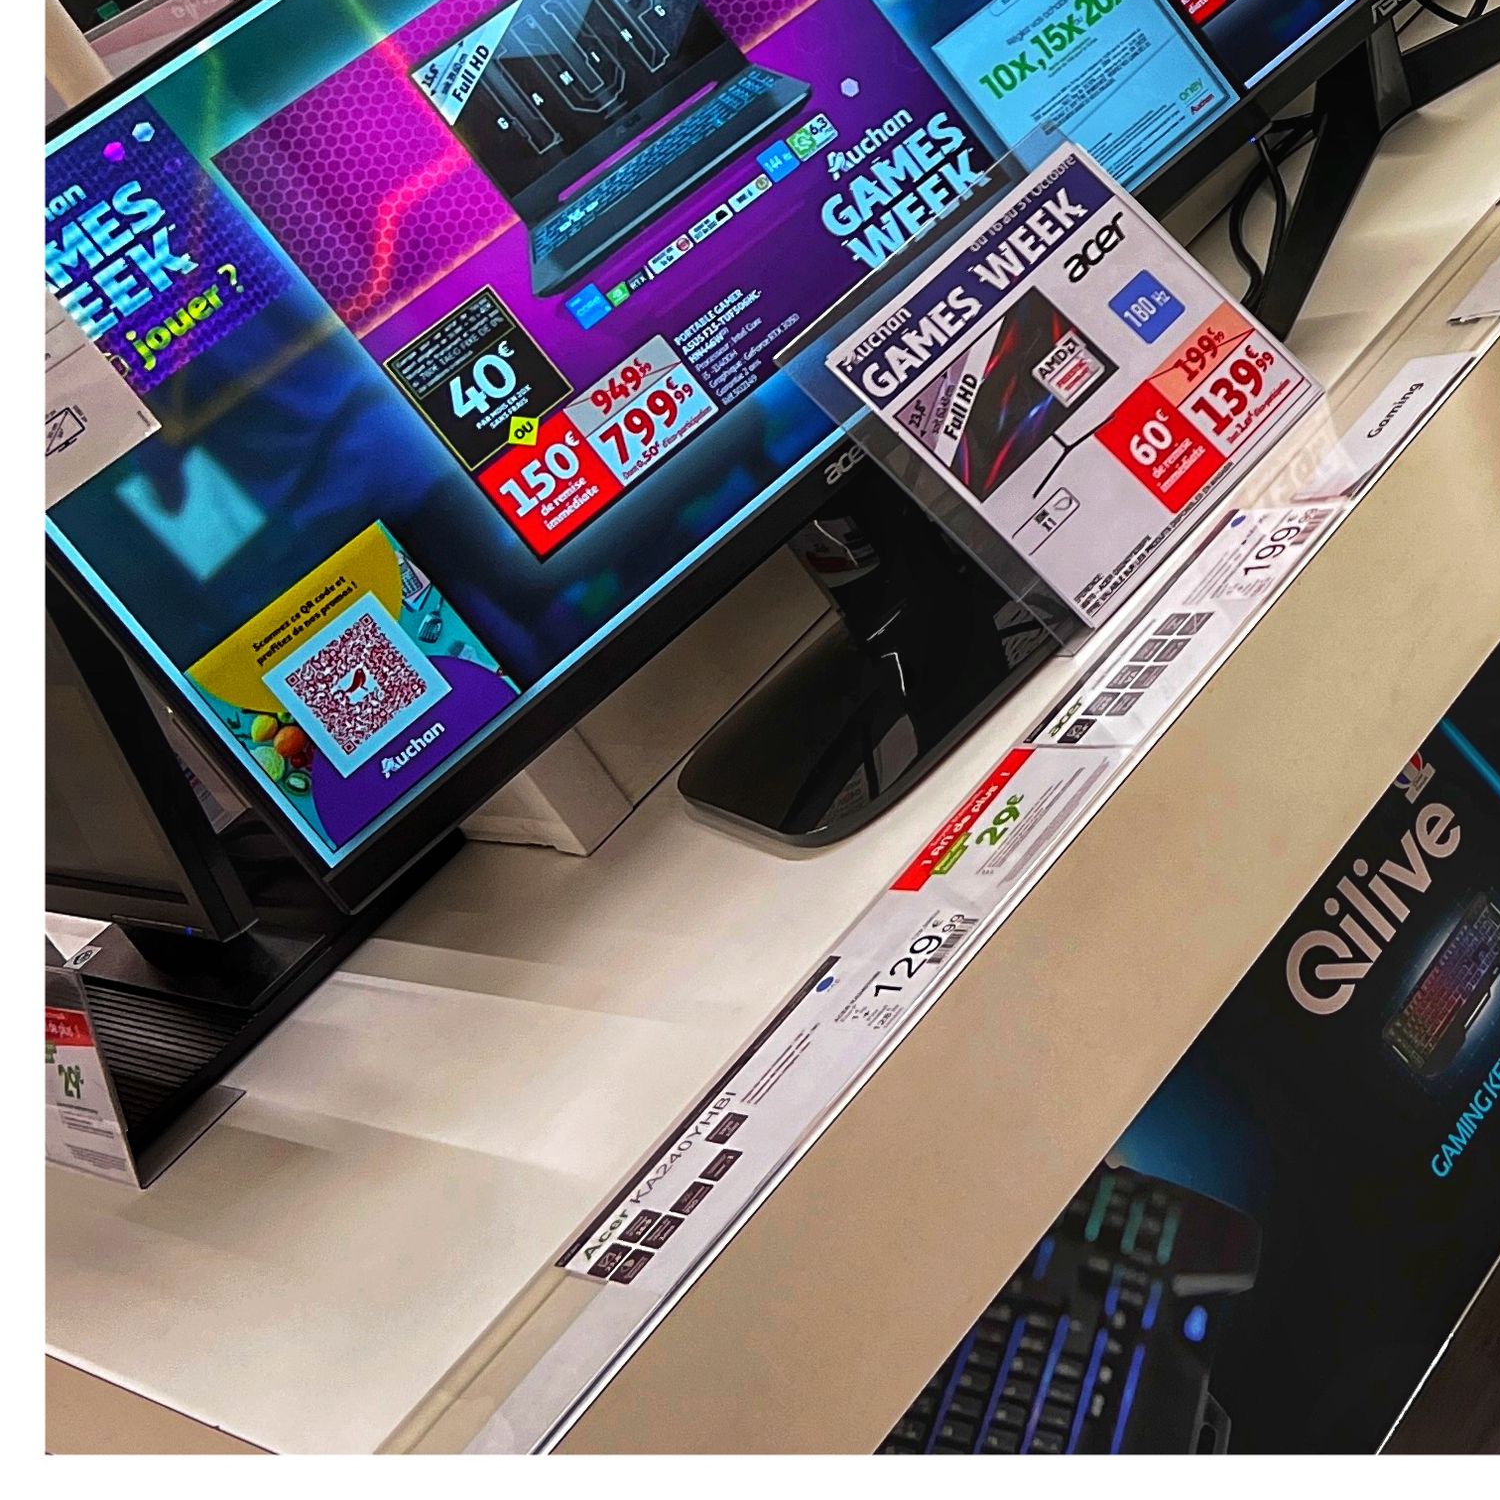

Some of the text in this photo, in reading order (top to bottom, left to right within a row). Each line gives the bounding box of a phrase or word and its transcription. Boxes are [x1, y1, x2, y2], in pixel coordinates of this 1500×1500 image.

[452, 44, 491, 104] Full HD
[820, 111, 967, 237] GAMES
[826, 107, 914, 182] Auchan
[841, 146, 990, 270] WEEK
[1063, 211, 1126, 284] acer
[61, 225, 199, 343] EEK
[125, 263, 245, 372] jouer ?
[713, 288, 744, 316] GAMER
[862, 284, 983, 399] GAMES
[969, 188, 1088, 291] WEEK
[1123, 288, 1173, 329] 180 Hz
[841, 306, 912, 372] Auchan
[448, 340, 516, 420] 40€
[944, 372, 980, 442] Full HD
[1366, 380, 1425, 441] Gaming
[513, 421, 534, 440] OU
[1128, 406, 1171, 467] 60€
[1151, 436, 1194, 480] de remise
[499, 430, 581, 518] 150€
[540, 477, 588, 517] de remise
[1158, 443, 1207, 494] immédiate
[543, 484, 600, 531] immédiate
[252, 618, 291, 653] Scannez
[298, 599, 316, 616] QR
[312, 582, 336, 605] code
[256, 634, 293, 668] profitez
[302, 614, 321, 632] nos
[318, 588, 353, 618] promos
[381, 721, 446, 780] Auchan
[1048, 697, 1084, 739] acer
[953, 784, 999, 833] de plus
[1285, 799, 1463, 1016] Qilive
[1431, 1087, 1494, 1179] GAMING
[581, 1208, 630, 1262] Acer
[628, 1090, 736, 1206] KA240YHBI
